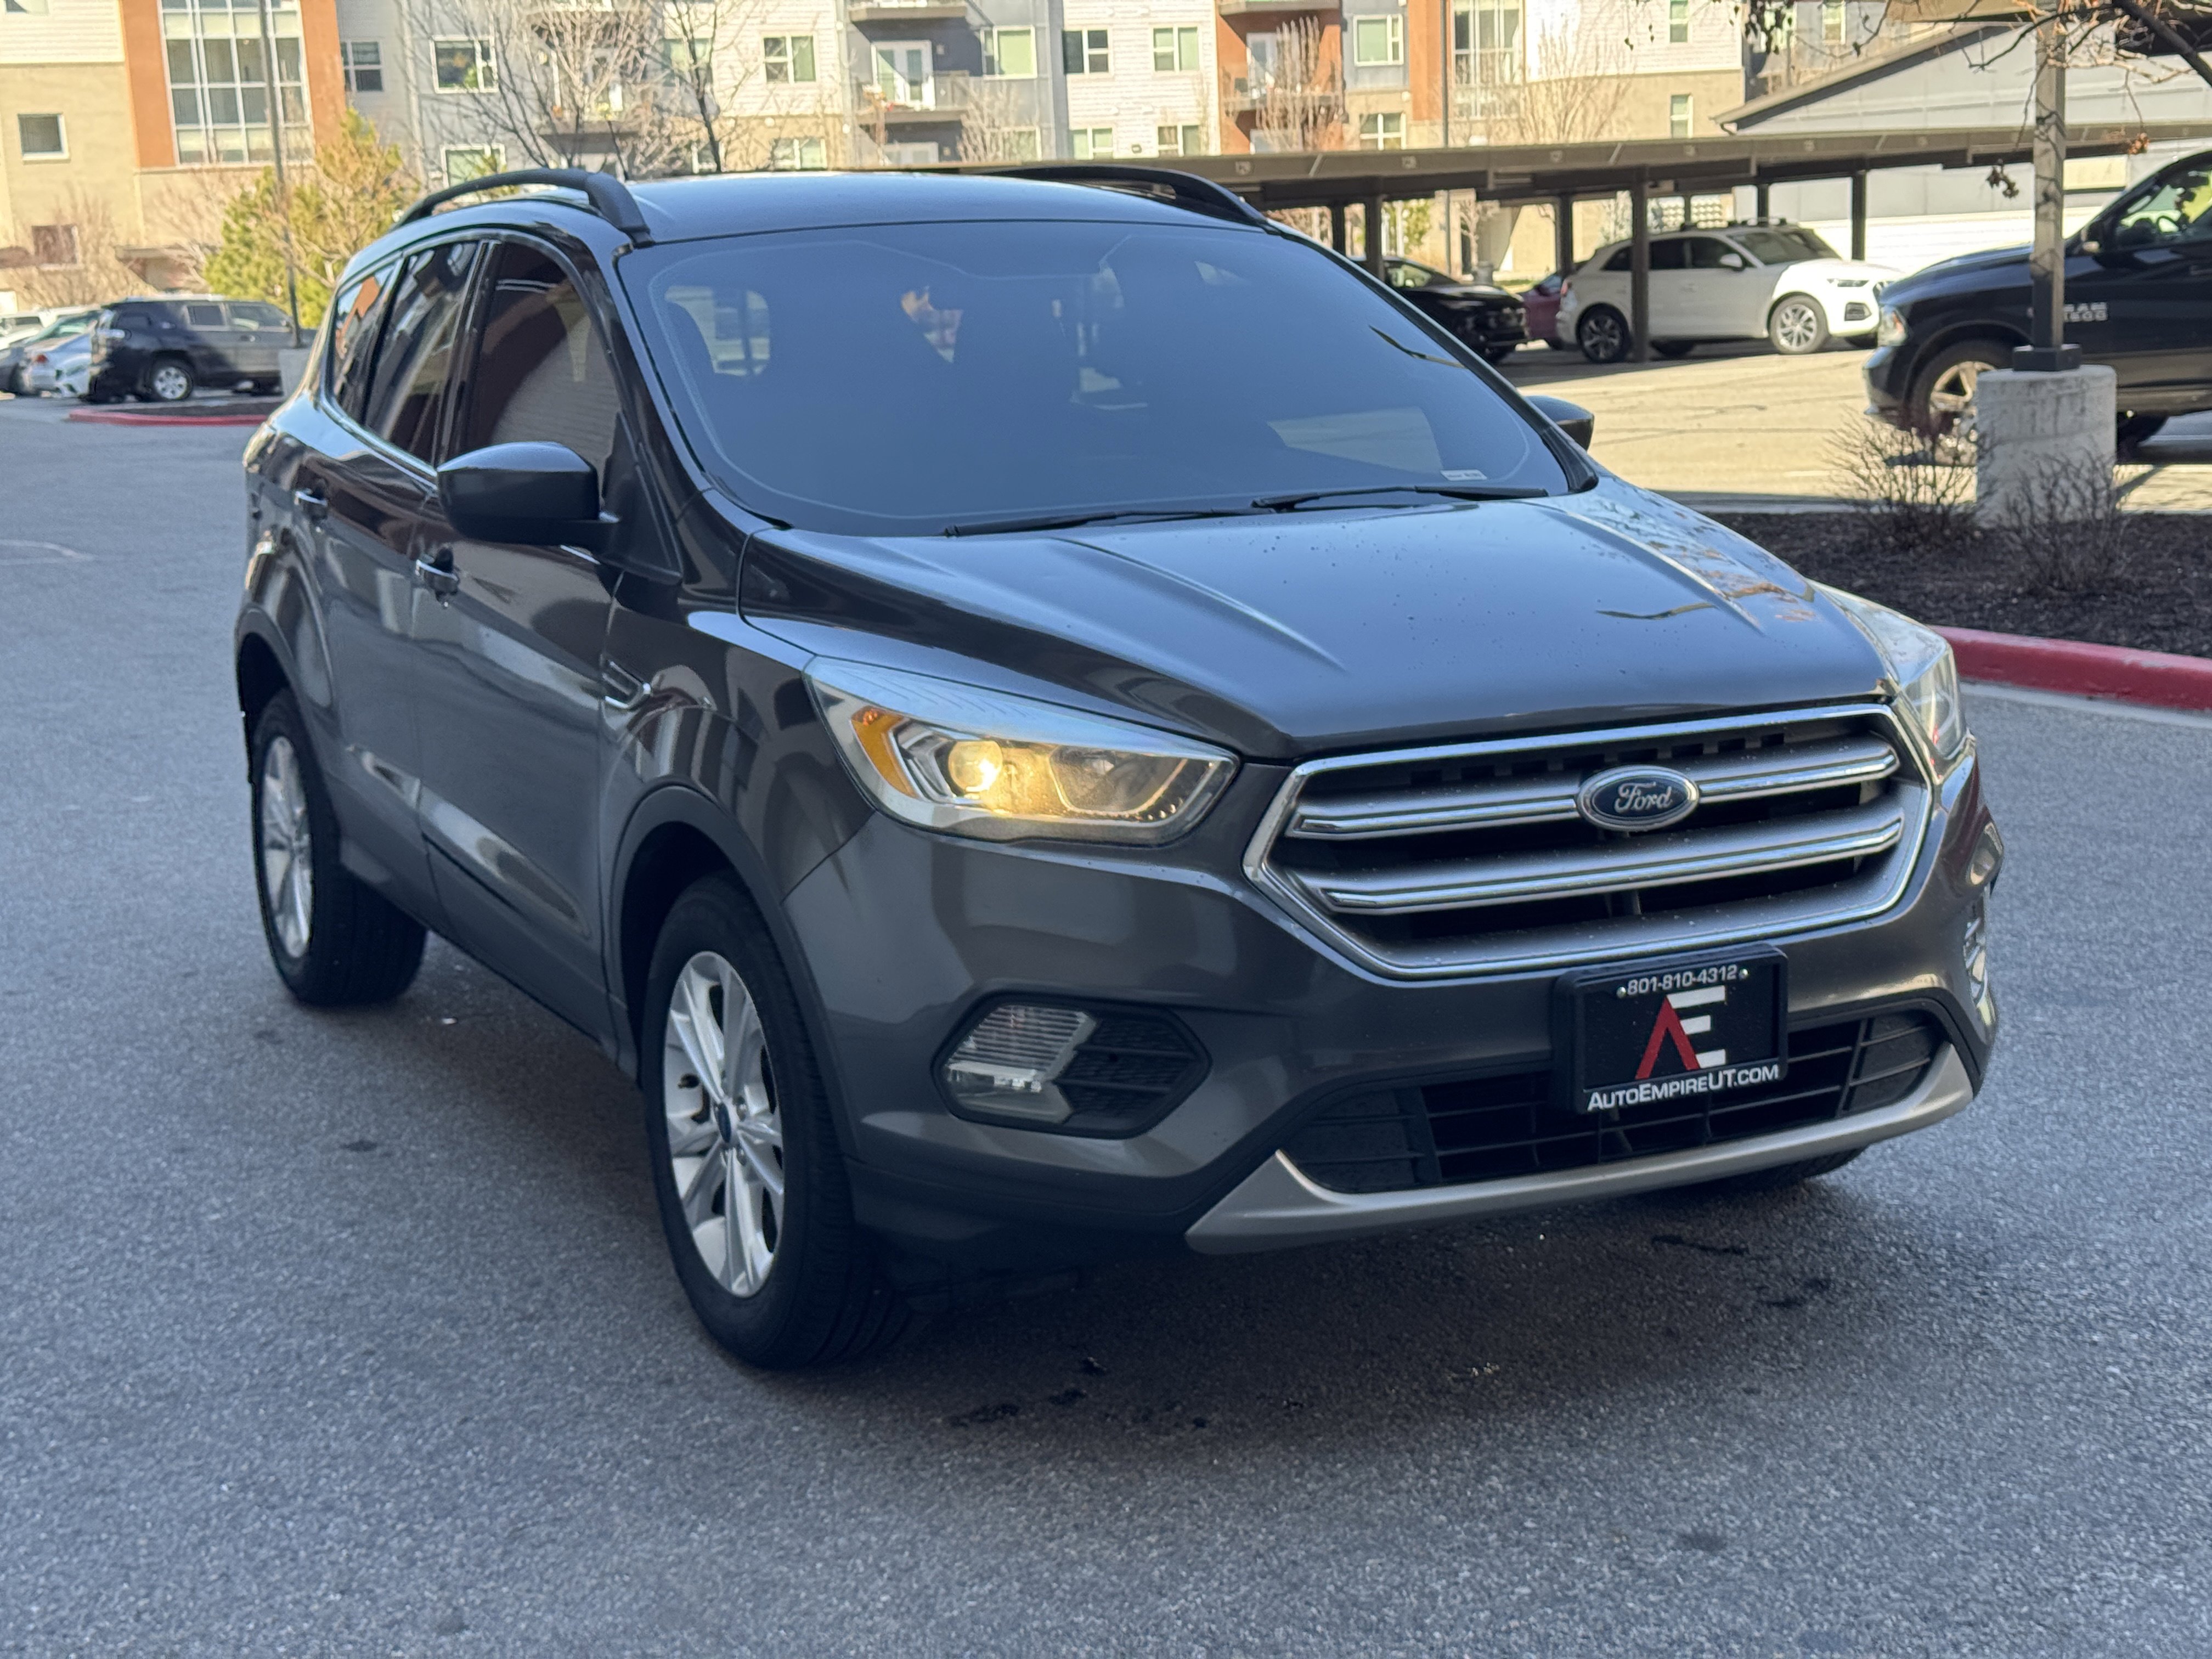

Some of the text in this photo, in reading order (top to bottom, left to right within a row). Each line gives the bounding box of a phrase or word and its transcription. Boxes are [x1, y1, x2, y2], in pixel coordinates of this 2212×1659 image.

[1615, 781, 1673, 813] Ford
[1627, 964, 1738, 996] 801-810-4312
[1587, 1064, 1779, 1111] AUTOEMPIREUT.COM
